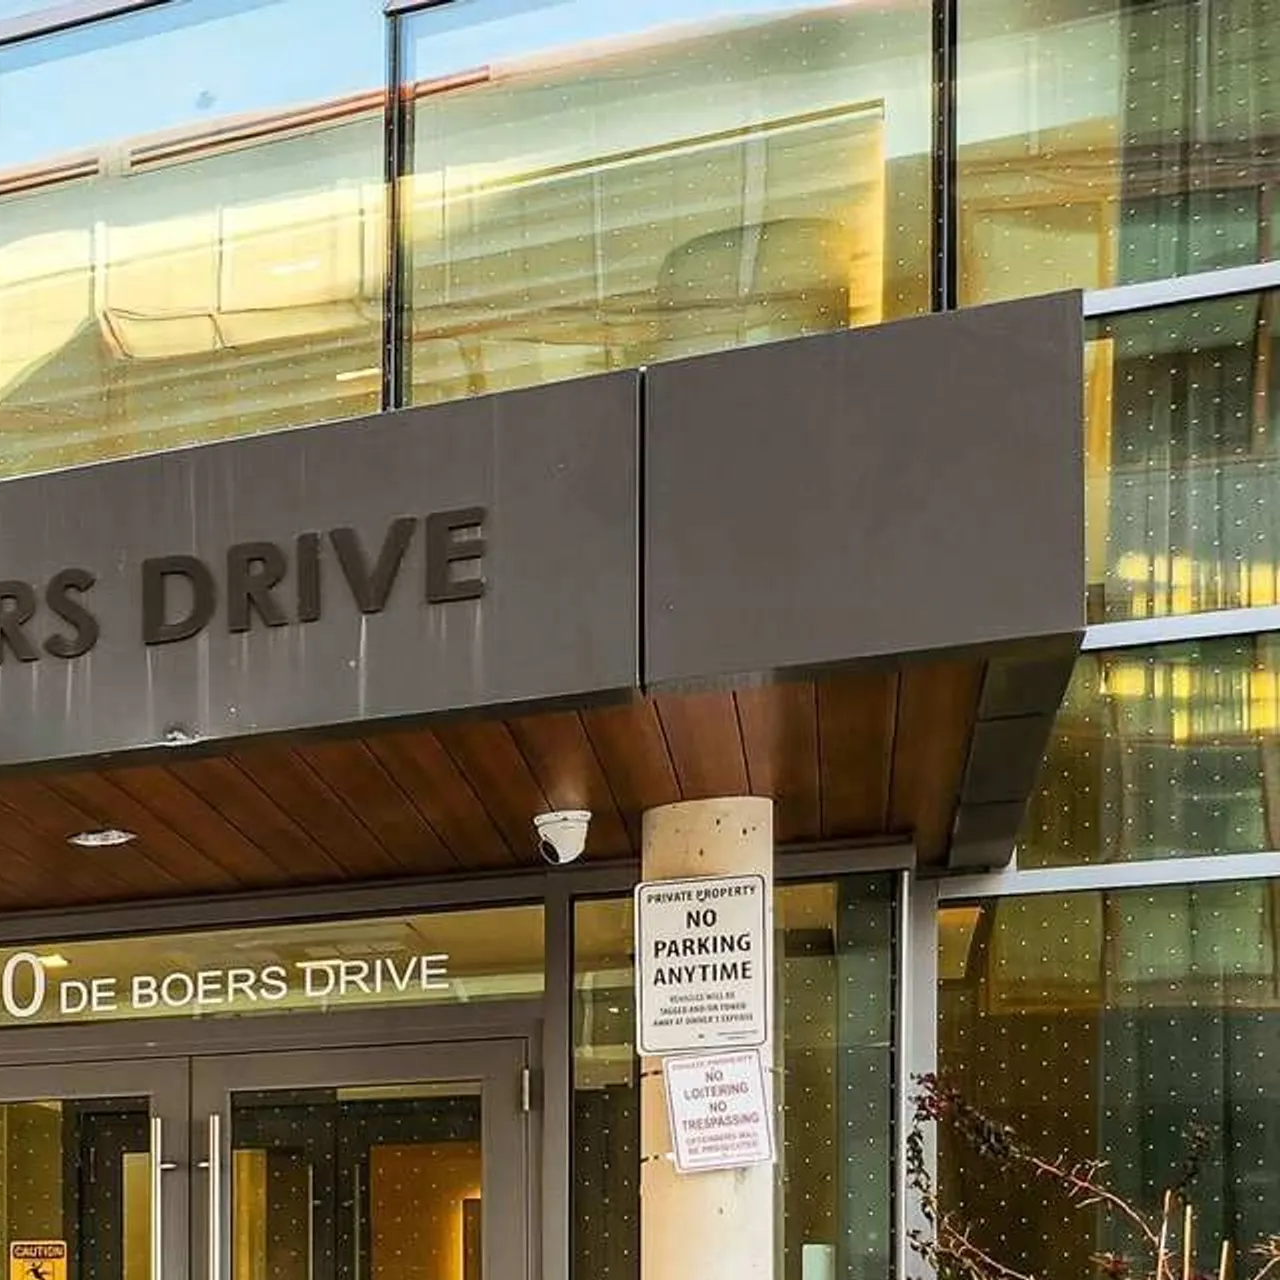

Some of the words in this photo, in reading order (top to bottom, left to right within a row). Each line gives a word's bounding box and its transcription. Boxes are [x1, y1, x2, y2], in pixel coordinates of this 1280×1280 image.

[142, 506, 487, 646] DRIVE
[646, 890, 693, 904] PRIVATE
[696, 885, 756, 901] PROPERTY
[686, 908, 717, 929] NO
[653, 933, 751, 958] PARKING
[653, 960, 753, 986] ANYTIME
[60, 977, 117, 1014] DE
[131, 965, 289, 1010] BOERS
[304, 954, 450, 998] DRIVE
[705, 1070, 723, 1082] NO
[683, 1081, 749, 1100] LOITERING
[709, 1101, 727, 1113] NO
[682, 1111, 760, 1131] TRESPASSING
[14, 1246, 64, 1257] CAUTION
